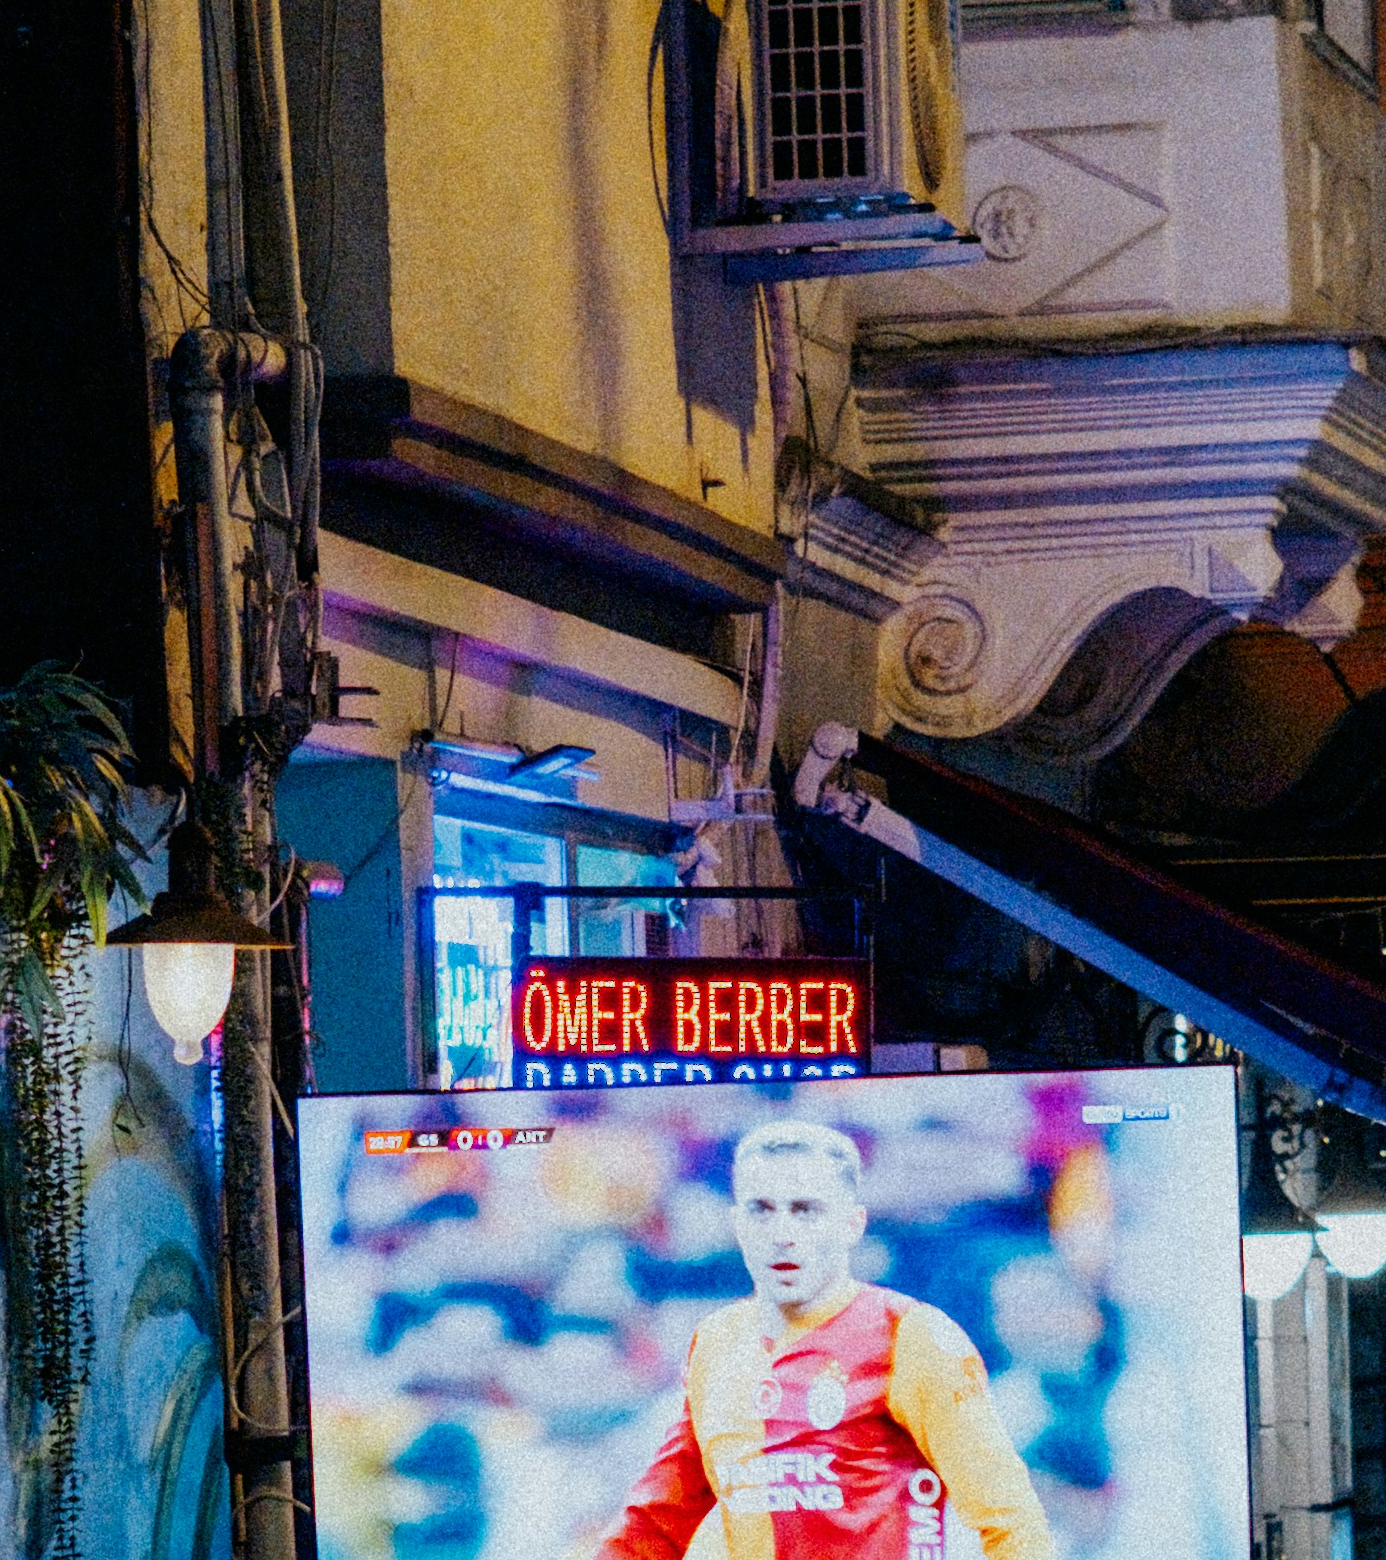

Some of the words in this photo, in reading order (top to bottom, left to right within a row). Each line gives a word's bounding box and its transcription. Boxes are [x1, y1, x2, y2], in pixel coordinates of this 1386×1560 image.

[524, 969, 650, 1053] ÖMER
[675, 980, 859, 1055] BERBER
[417, 1133, 439, 1147] GS
[514, 1130, 547, 1144] ANT
